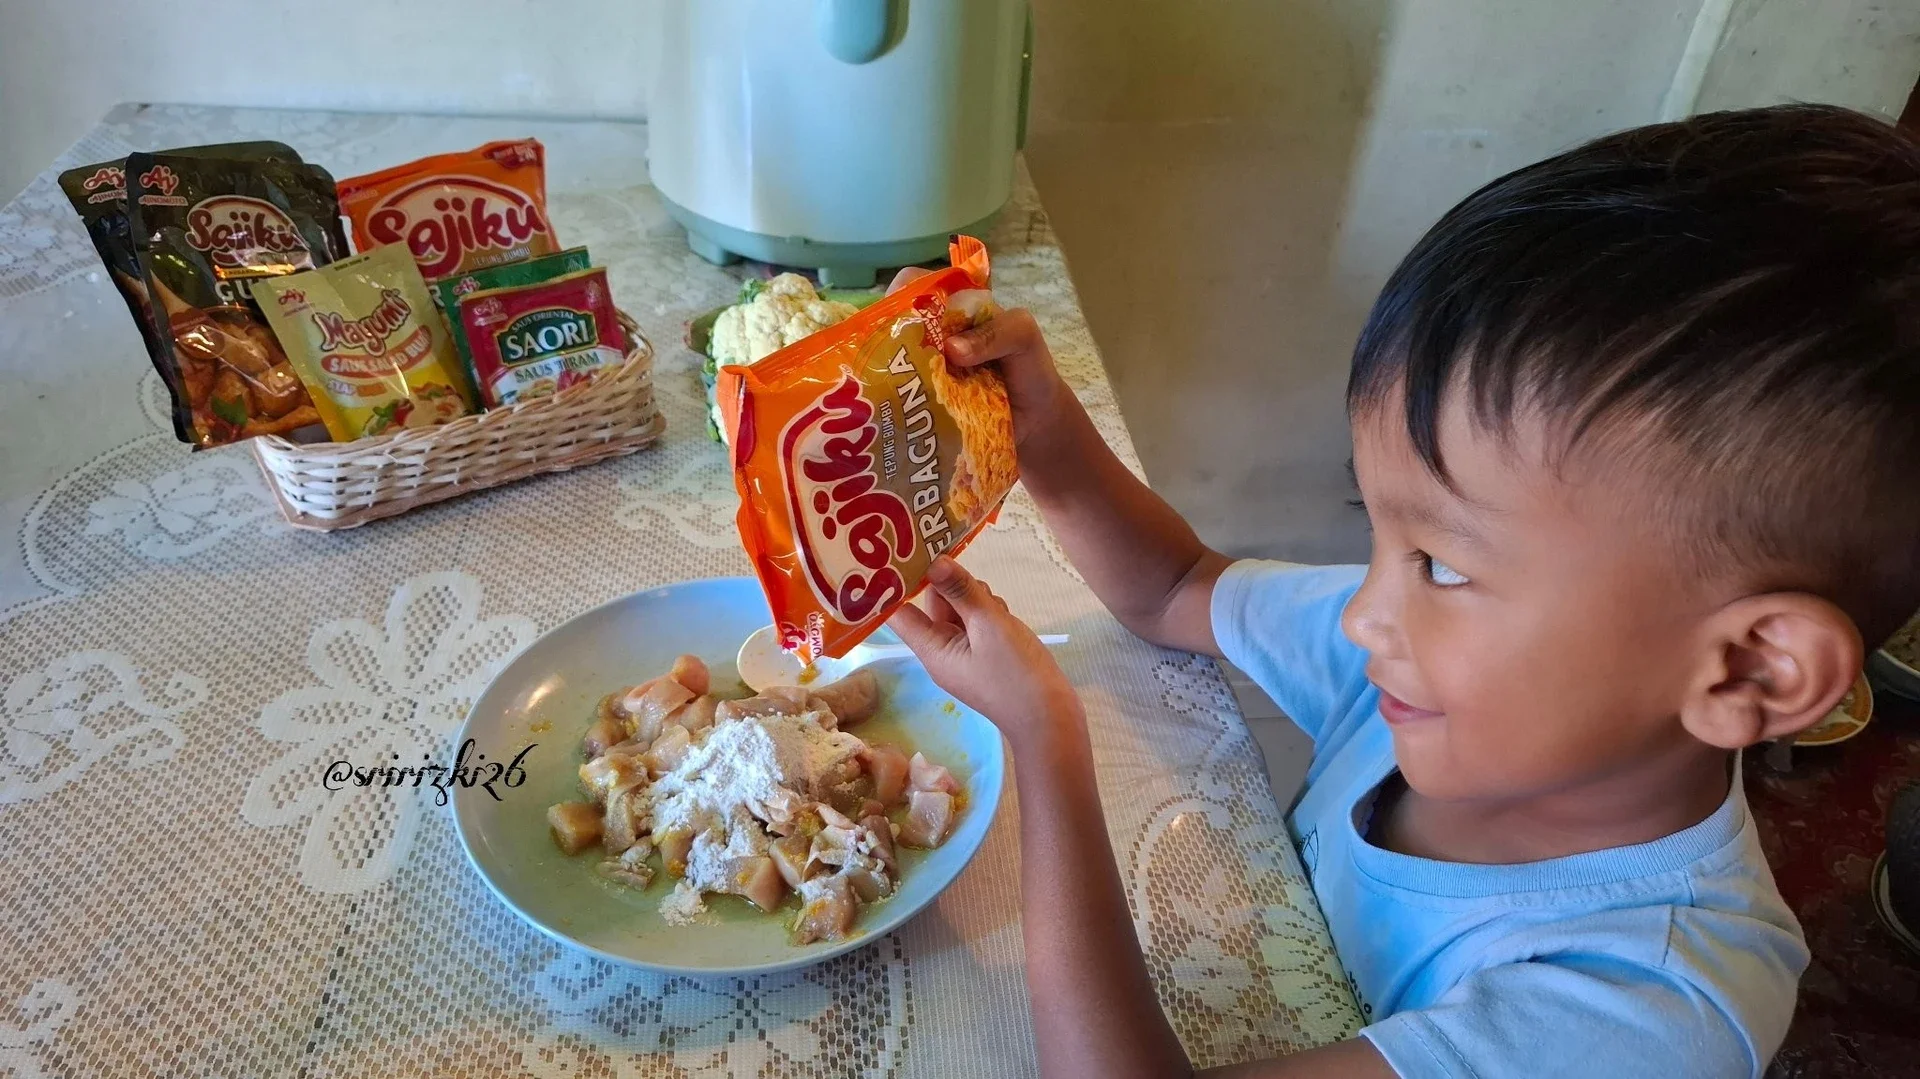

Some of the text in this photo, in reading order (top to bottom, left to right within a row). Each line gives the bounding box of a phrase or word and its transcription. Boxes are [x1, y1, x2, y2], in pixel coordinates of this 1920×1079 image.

[185, 208, 301, 266] Sajiku
[367, 196, 547, 279] Sajiku
[312, 288, 411, 356] Mayumi
[506, 319, 590, 359] SAORI
[512, 317, 532, 332] SAUS
[515, 352, 601, 383] SAUS TIRAM
[880, 399, 899, 482] TEPUNG BUMBU
[888, 345, 955, 564] ERBAGUNA
[801, 370, 917, 624] Sajiku
